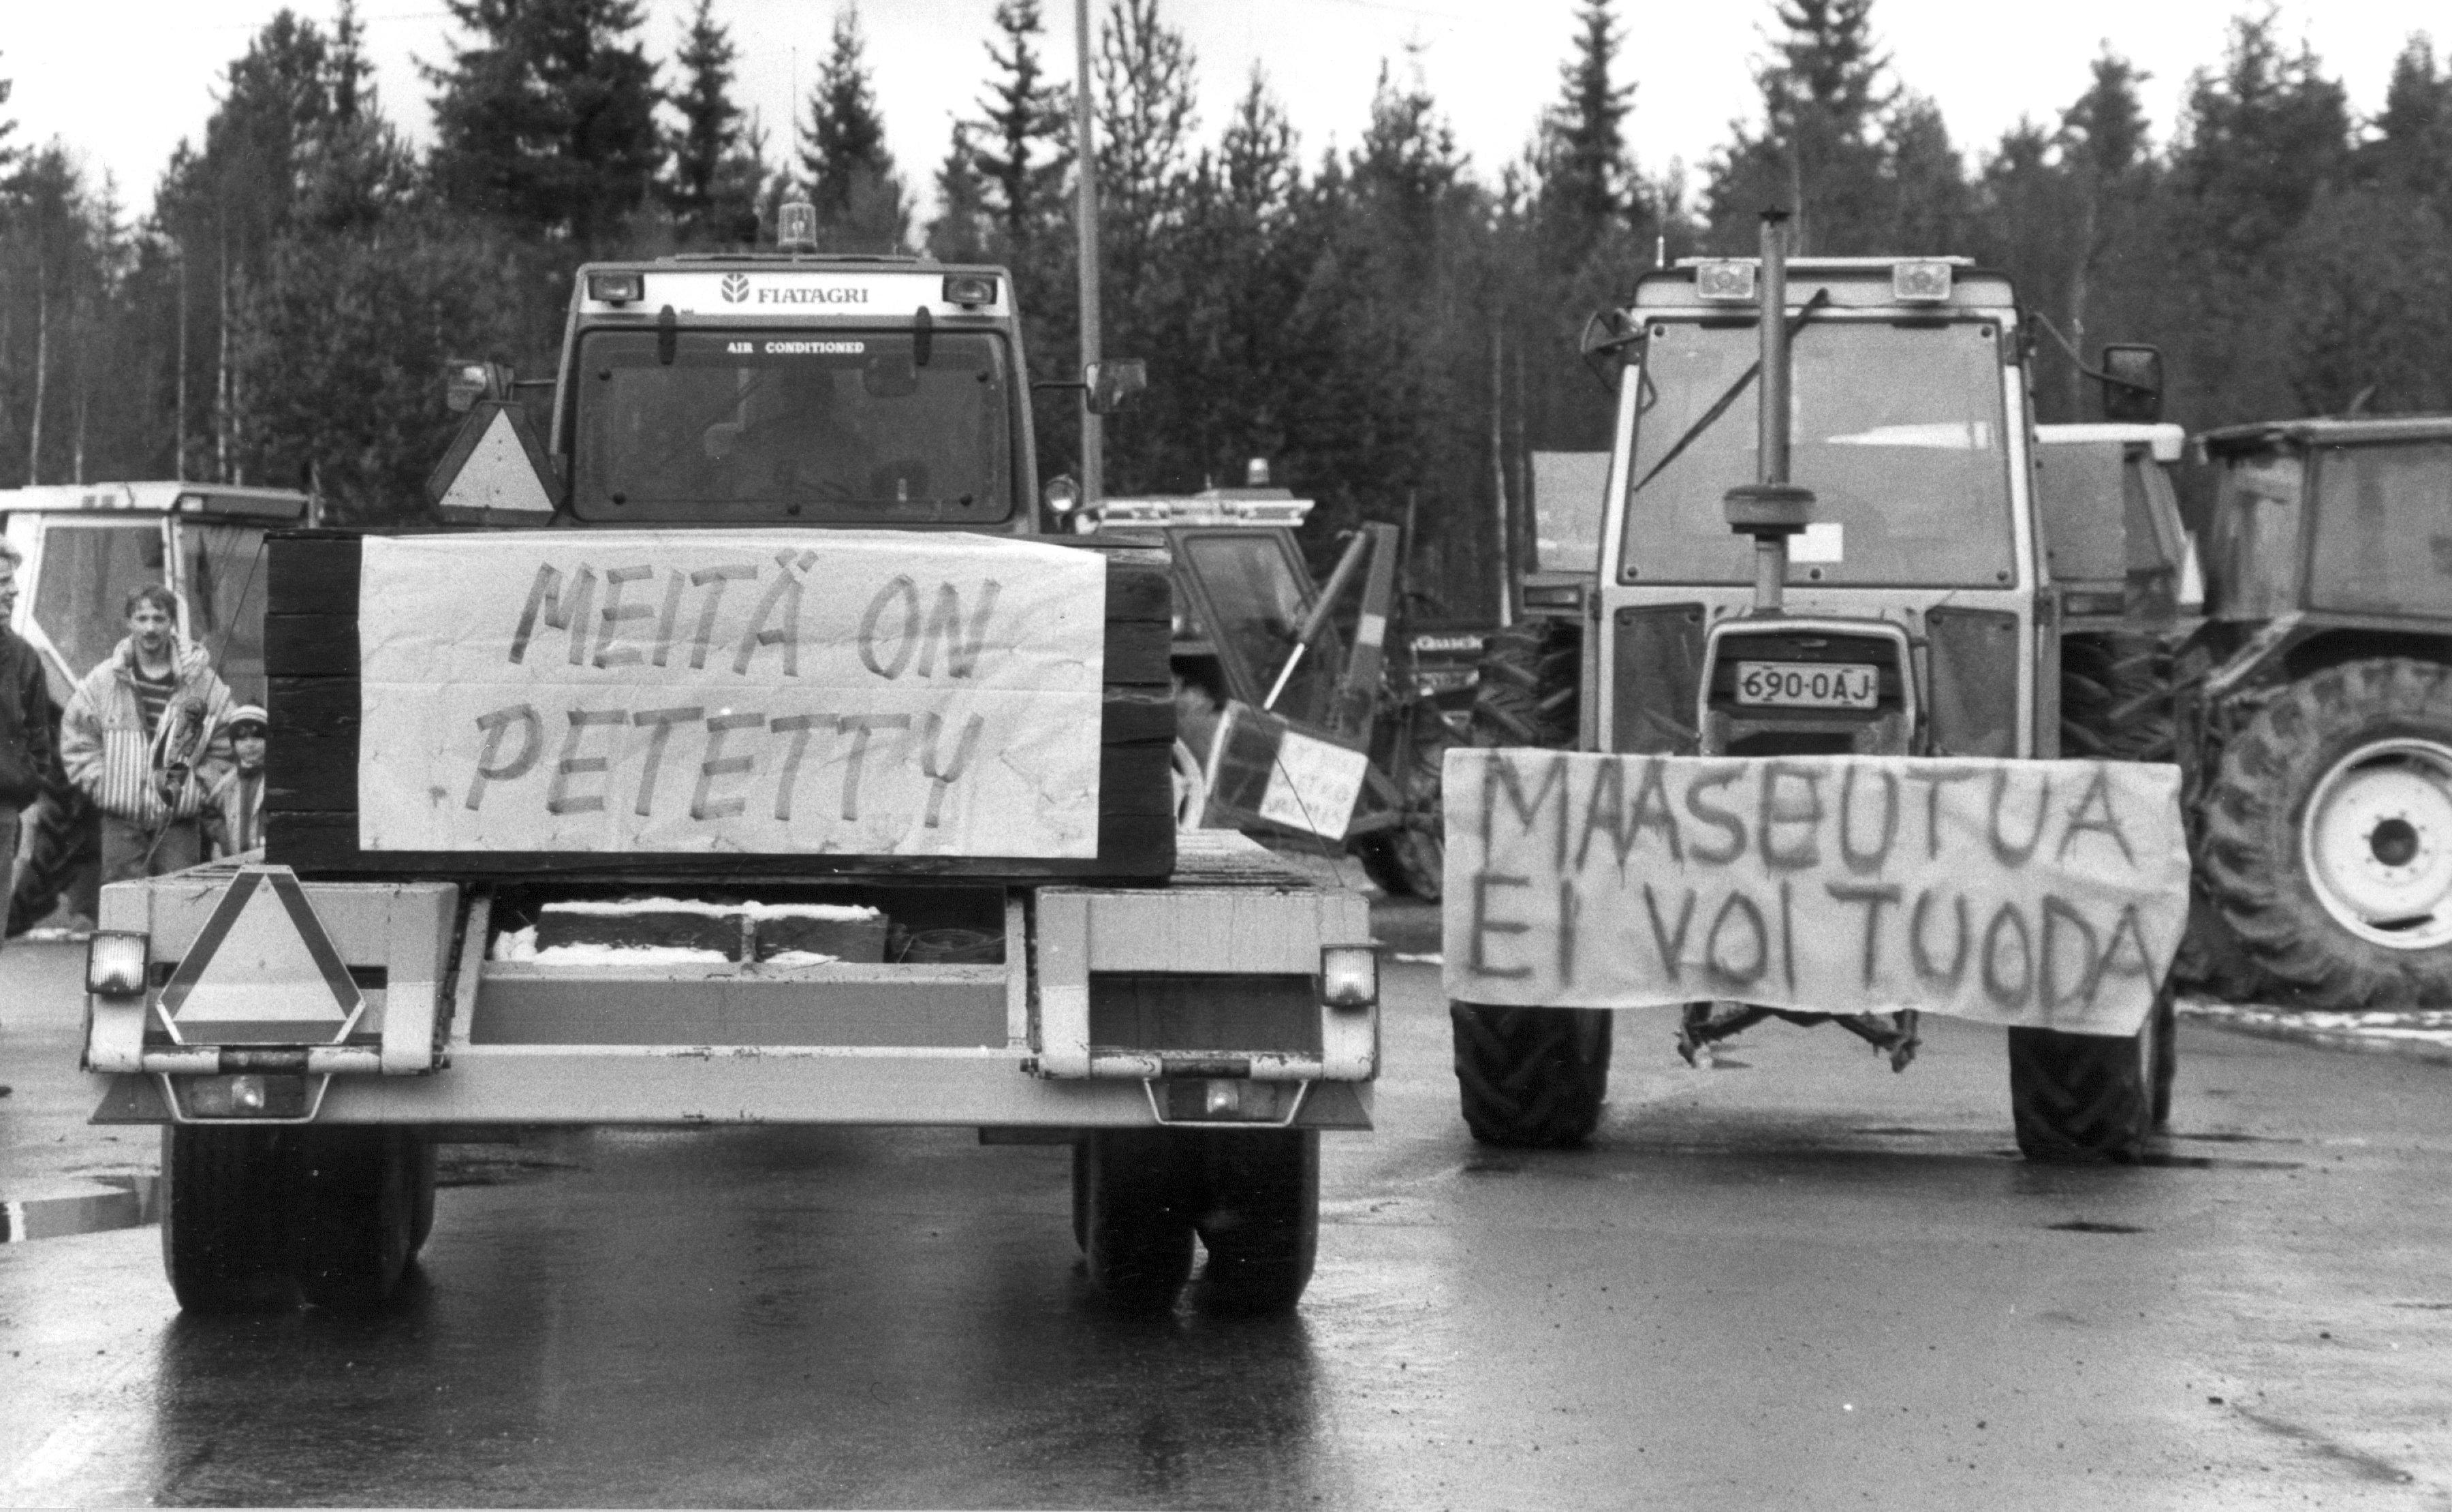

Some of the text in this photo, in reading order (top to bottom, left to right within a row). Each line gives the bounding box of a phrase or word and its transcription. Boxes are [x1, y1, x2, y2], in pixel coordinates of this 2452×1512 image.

[727, 341, 864, 353] AIR CONDITIONED
[757, 287, 868, 304] FIATAGRI
[507, 549, 1002, 680] MEITÄ ON
[465, 703, 985, 829] PETETTY
[1483, 755, 2136, 883] MAASEUTUA
[1471, 874, 2160, 1009] EI VOI TUODA
